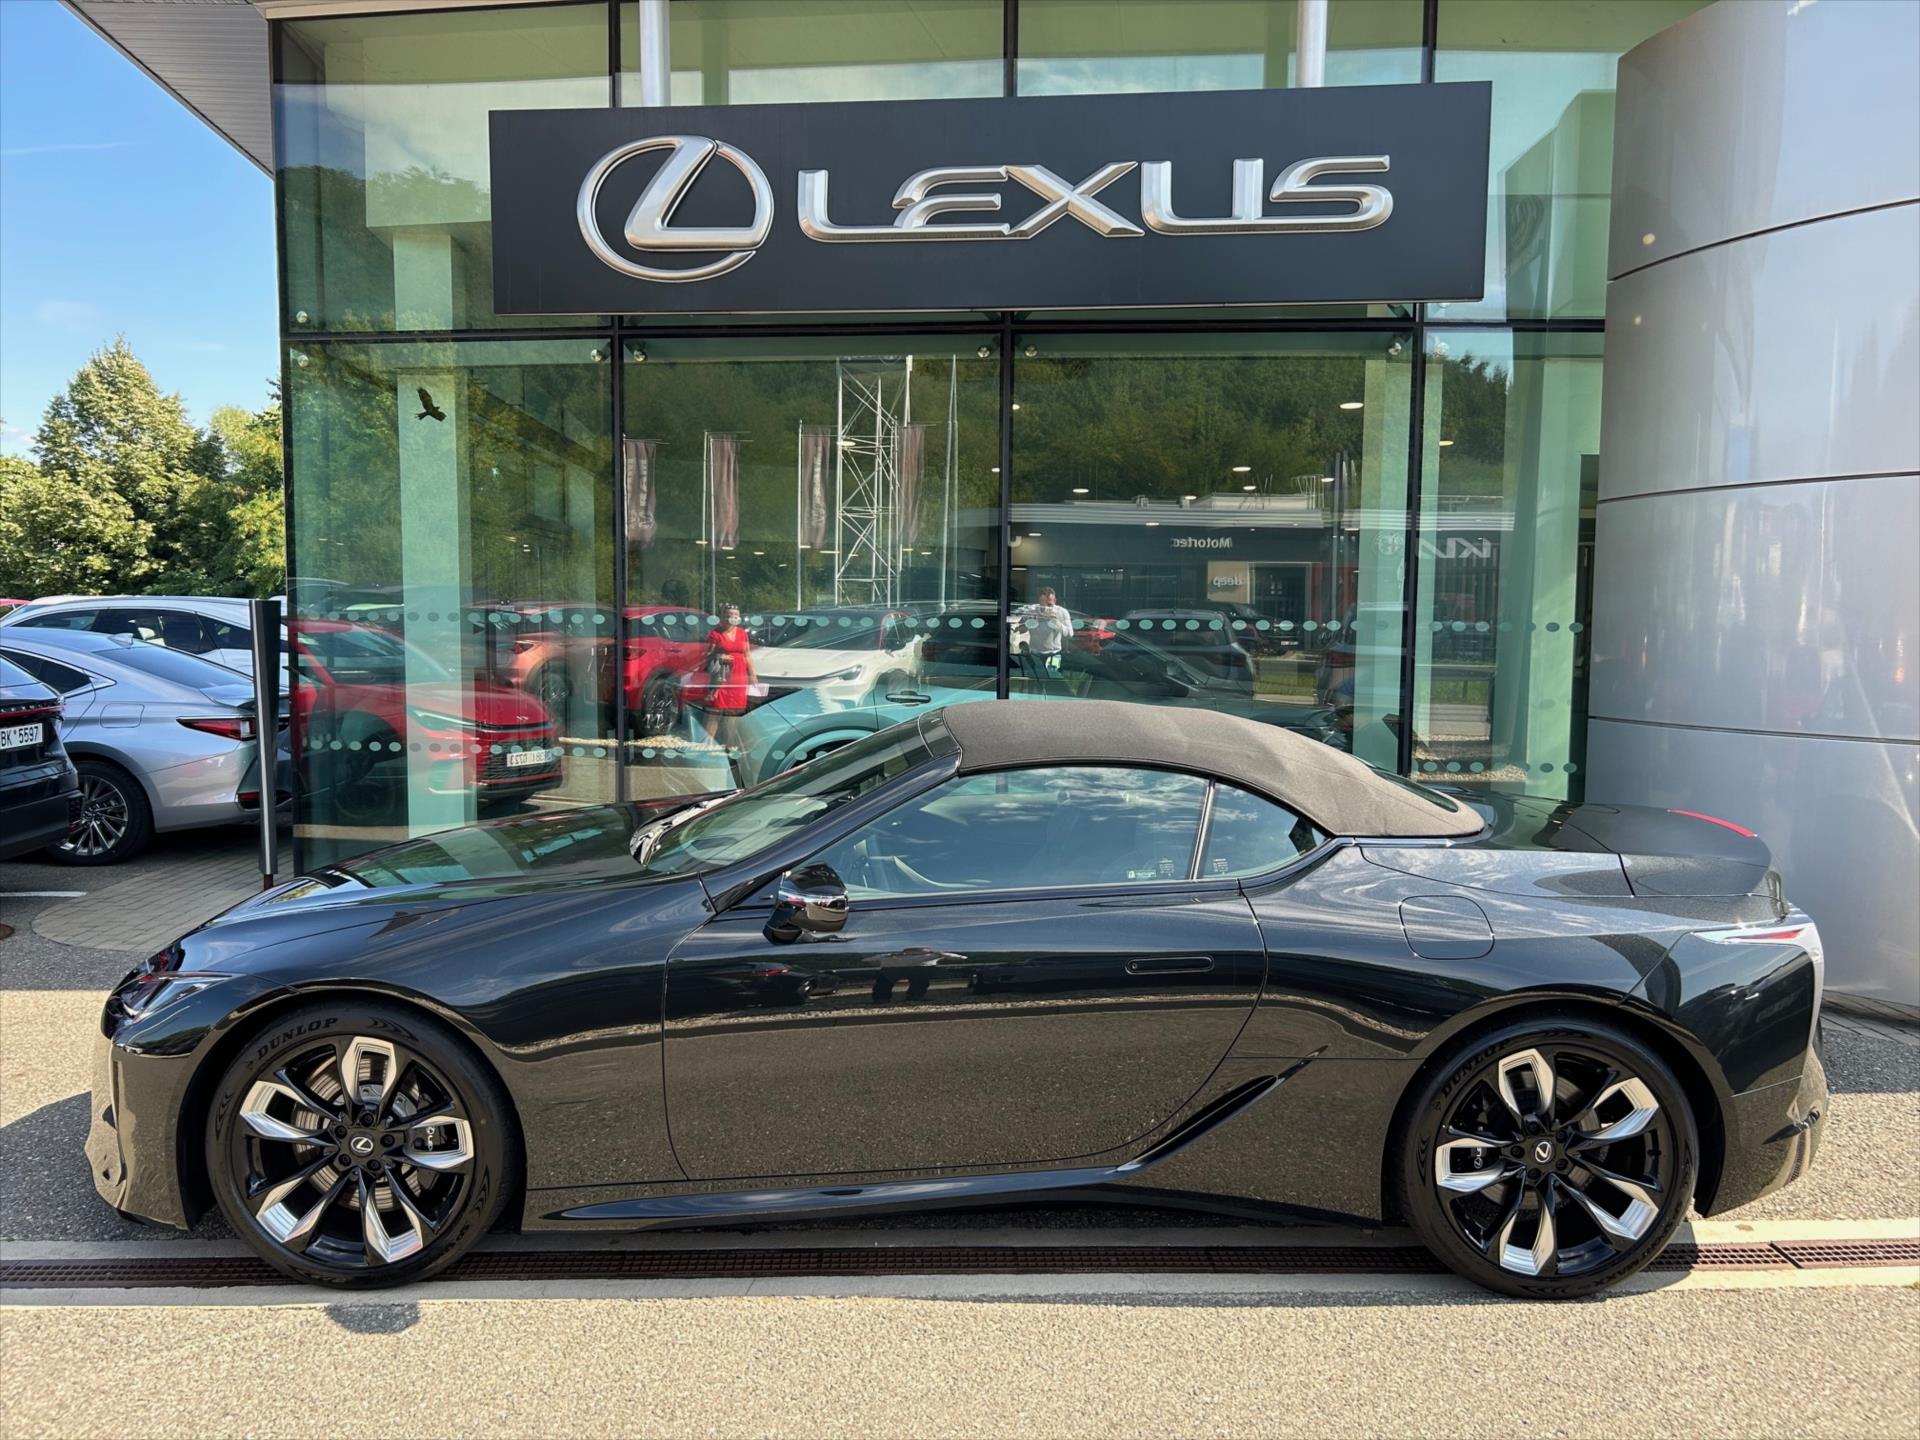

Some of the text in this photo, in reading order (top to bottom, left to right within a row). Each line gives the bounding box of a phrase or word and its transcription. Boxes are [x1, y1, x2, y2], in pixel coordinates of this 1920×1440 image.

[798, 153, 1394, 245] LEXUS
[1, 726, 39, 747] BK 5597
[257, 1017, 338, 1059] DUNLOP
